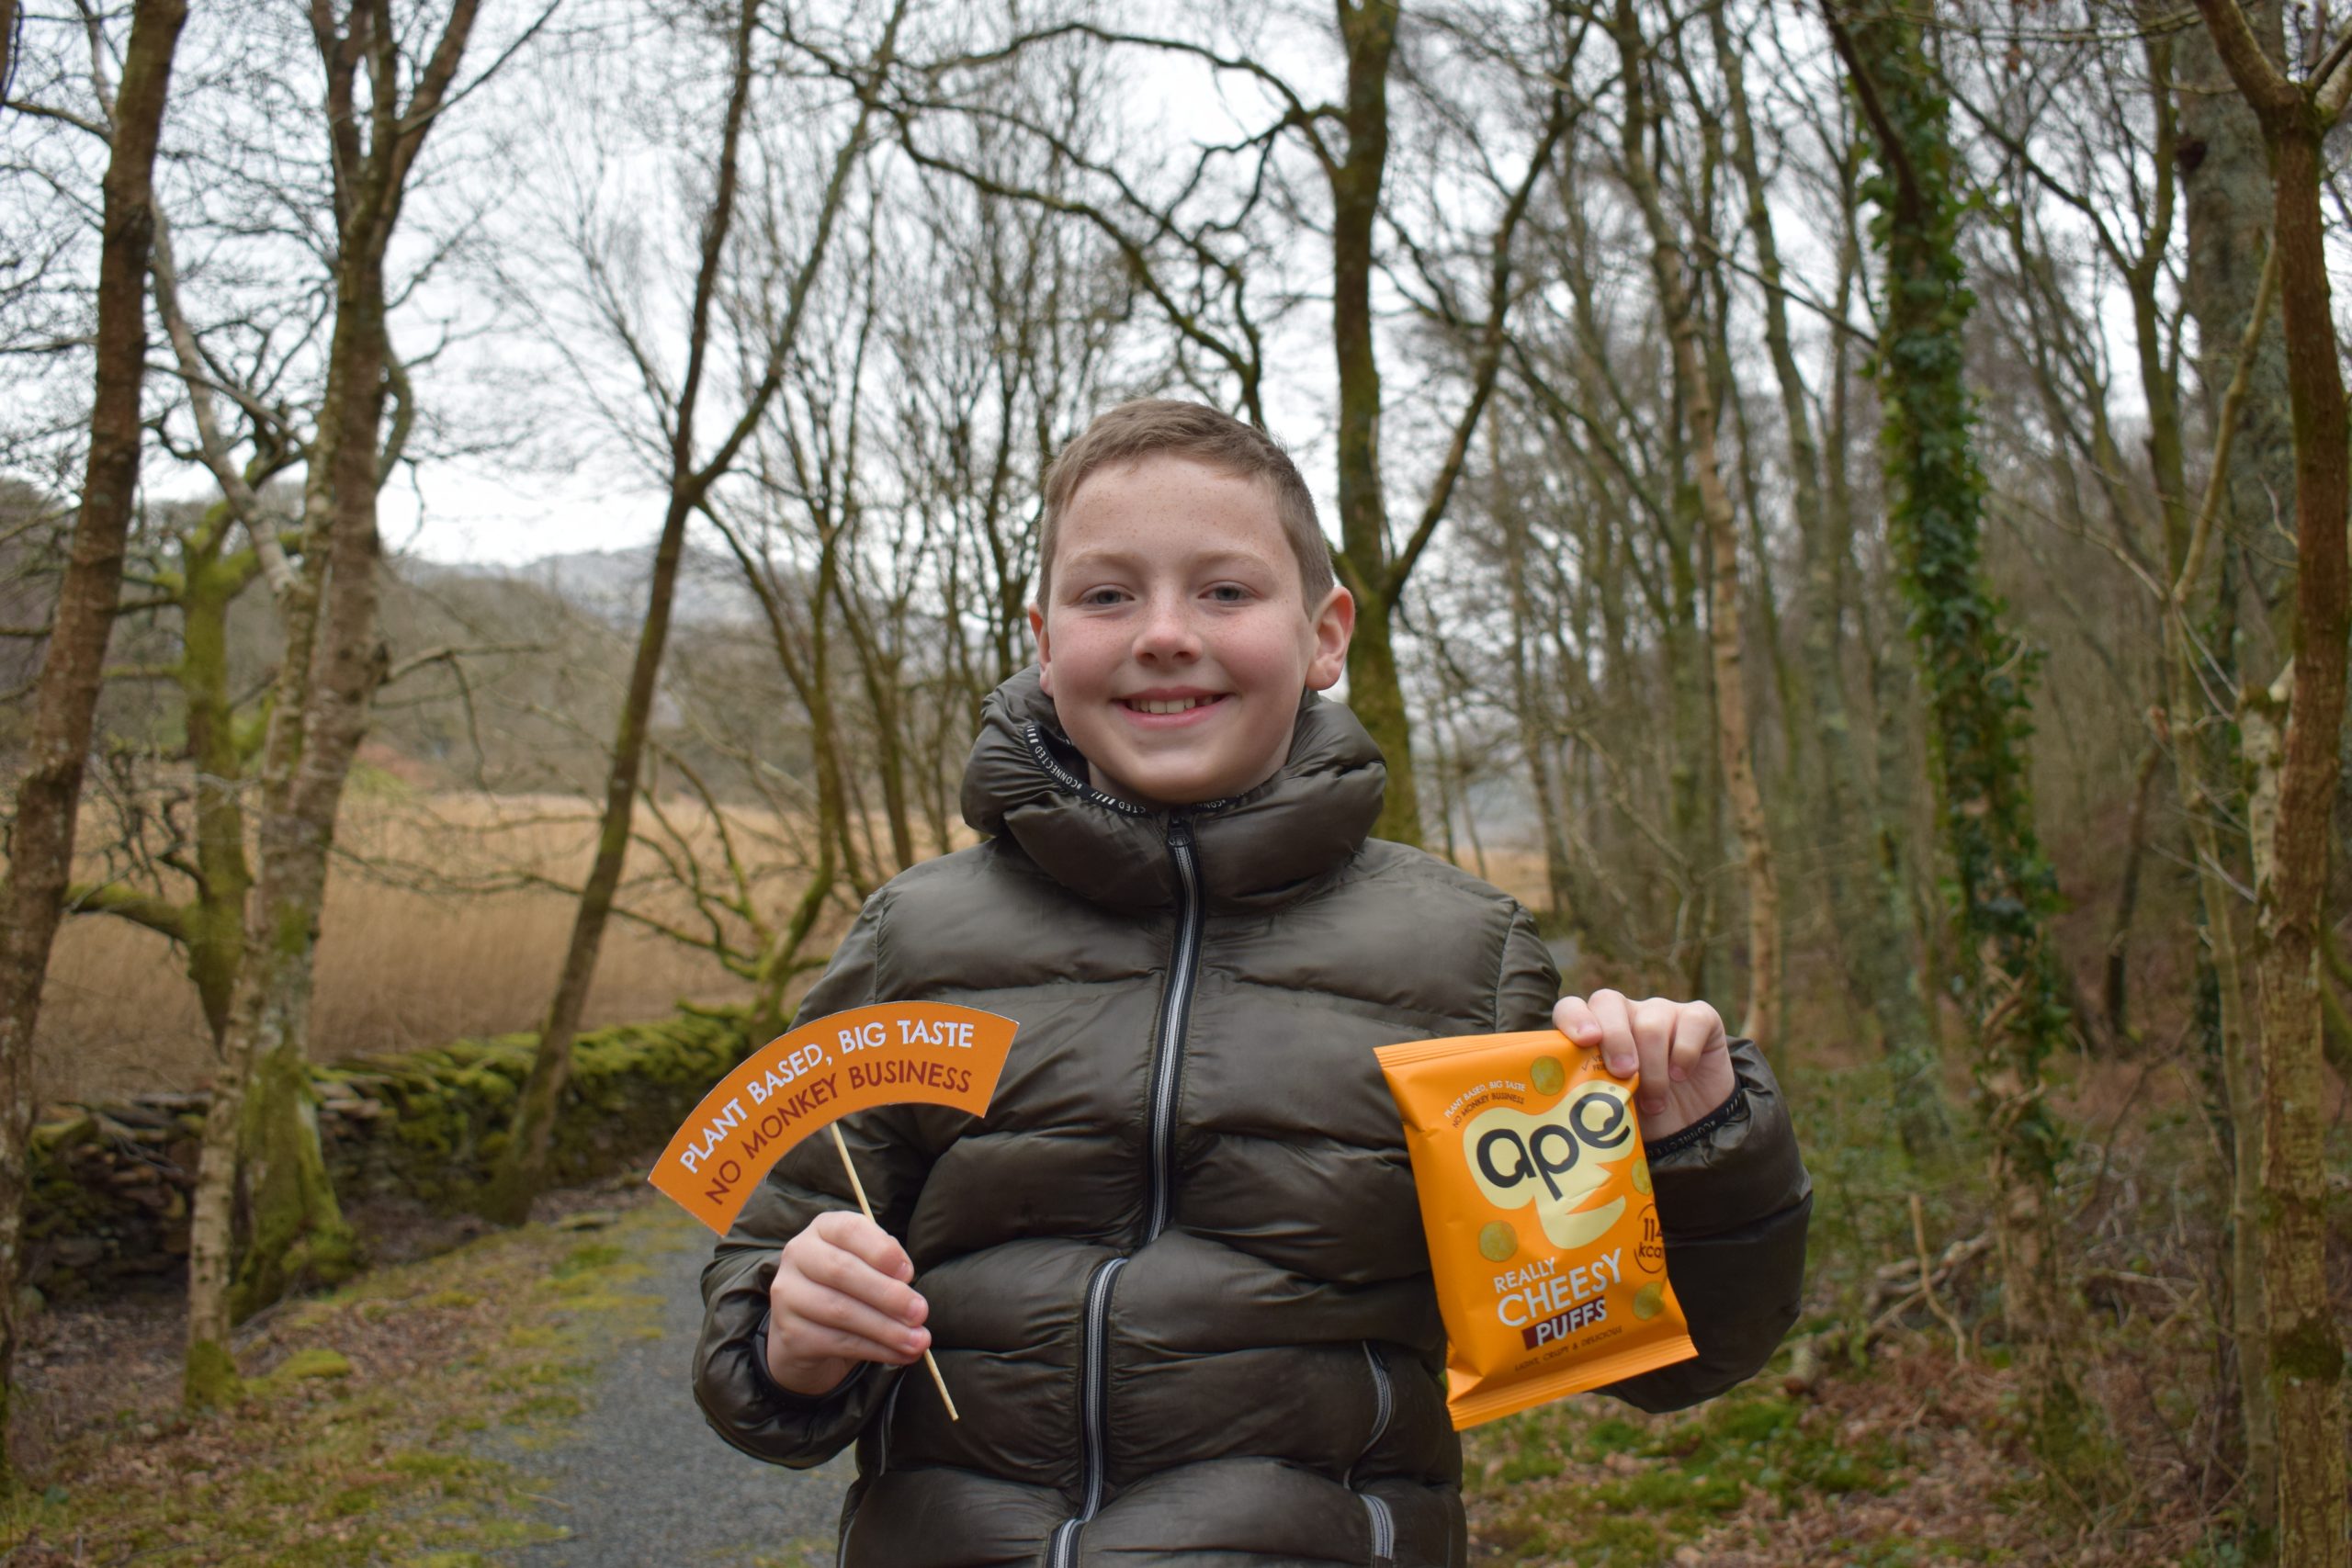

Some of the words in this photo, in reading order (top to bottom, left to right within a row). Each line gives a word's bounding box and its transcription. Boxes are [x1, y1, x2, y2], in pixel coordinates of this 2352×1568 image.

[679, 1098, 748, 1174] PLANT
[746, 1043, 833, 1106] BASED,
[837, 1021, 888, 1055] BIG
[897, 1020, 975, 1049] TASTE
[1444, 1097, 1464, 1119] PLANT
[1488, 1080, 1503, 1089] BIG
[1505, 1080, 1526, 1092] TASTE
[1452, 1115, 1463, 1128] NO
[1462, 1094, 1489, 1117] MONKEY
[1491, 1092, 1525, 1104] BUSINESS
[704, 1159, 742, 1206] NO
[741, 1073, 842, 1160] MONKEY
[847, 1059, 973, 1094] BUSINESS
[1476, 1092, 1631, 1201] ape
[1639, 1241, 1664, 1259] kca
[1493, 1257, 1555, 1293] REALLY
[1498, 1247, 1623, 1326] CHEESY
[1535, 1299, 1607, 1347] PUFFS
[1580, 1325, 1623, 1347] DELICIOUS
